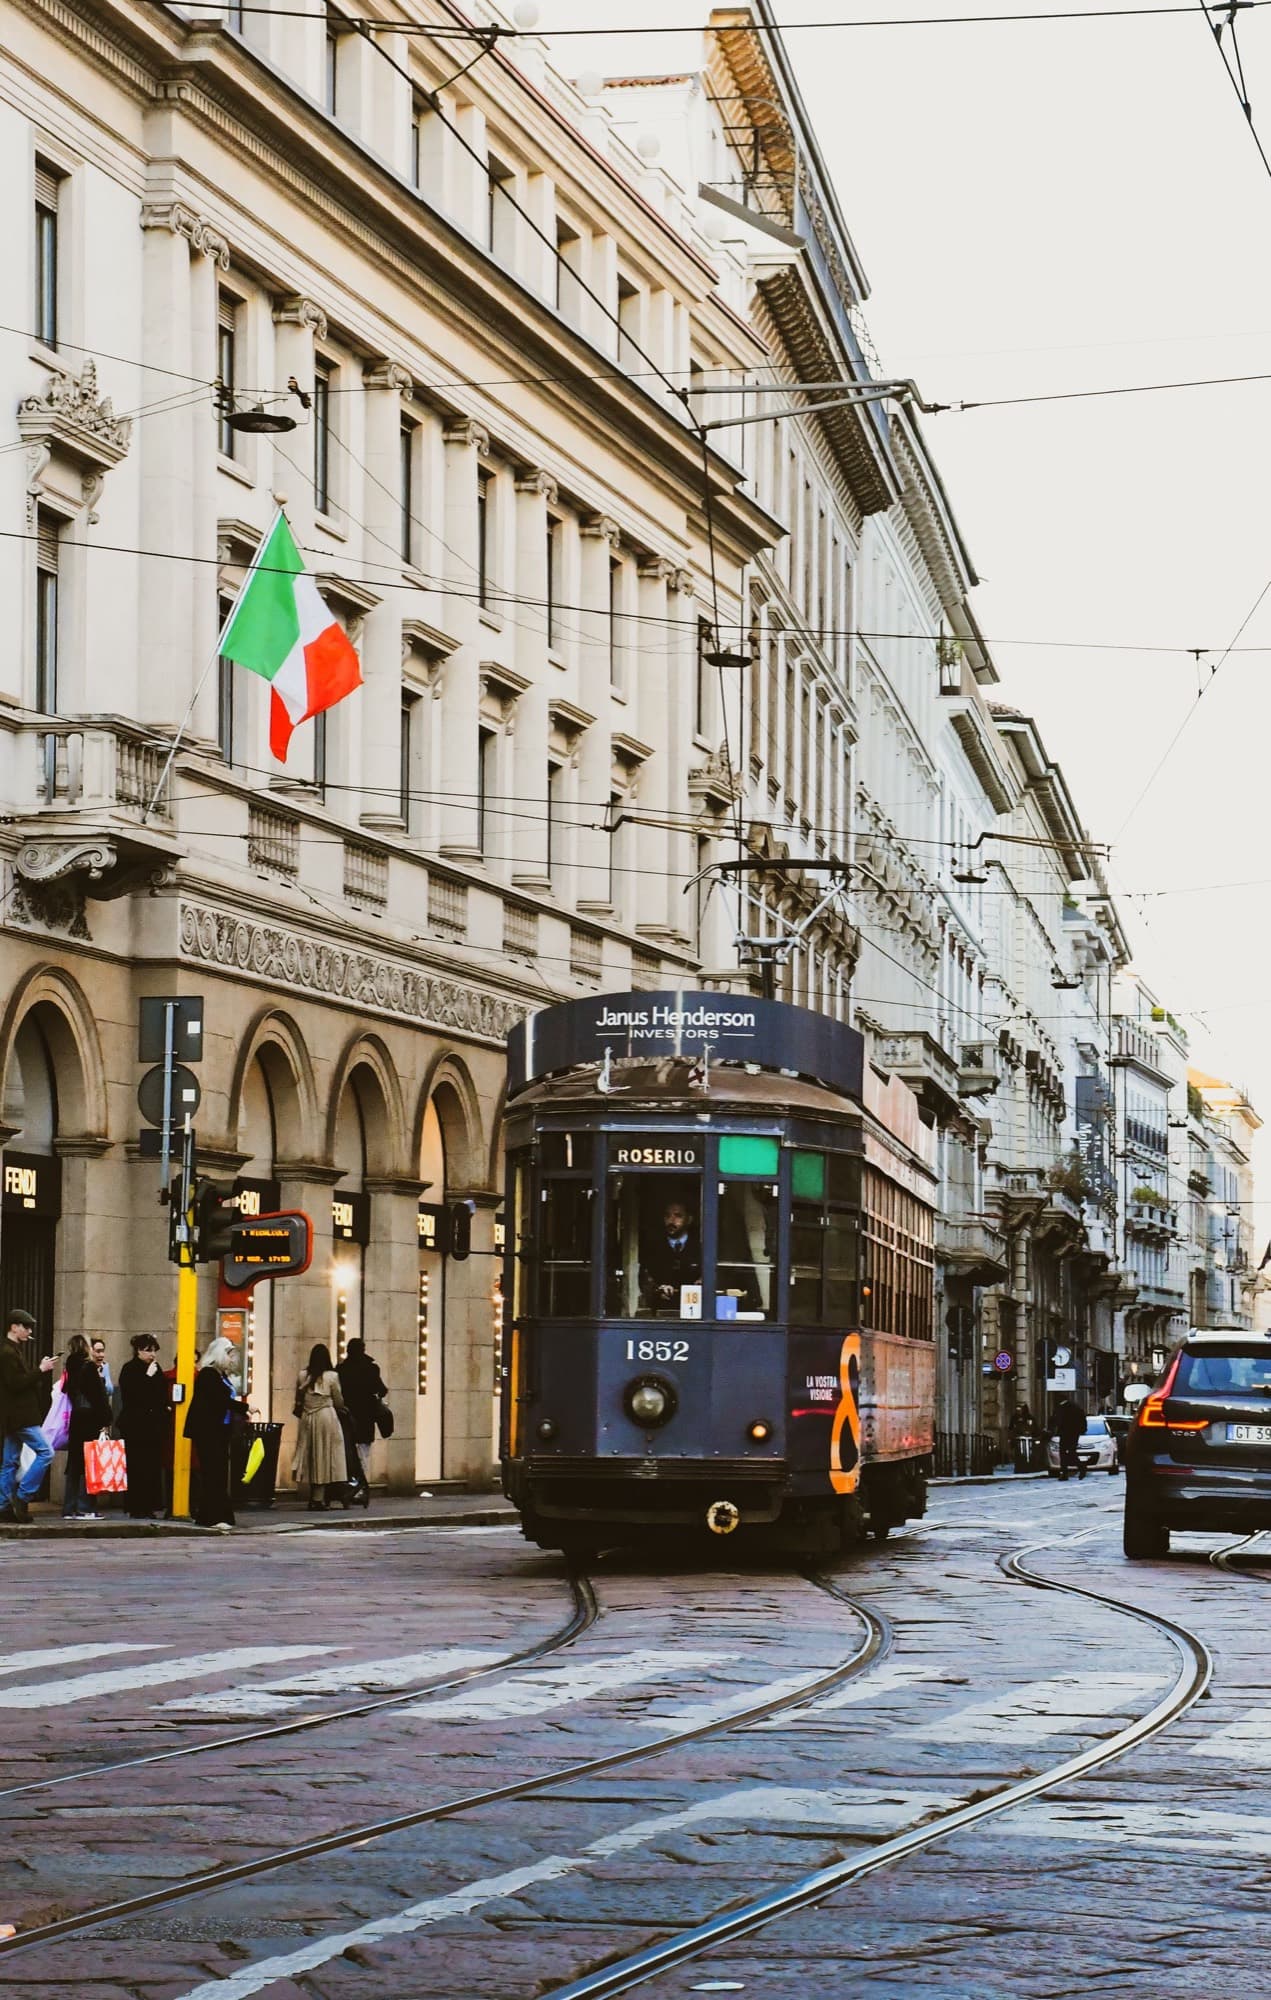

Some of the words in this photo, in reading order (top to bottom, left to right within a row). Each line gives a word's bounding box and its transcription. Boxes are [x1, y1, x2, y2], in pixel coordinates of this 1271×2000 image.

[595, 1006, 648, 1026] Janus
[652, 1006, 755, 1026] Henderson
[629, 1029, 719, 1039] INVESTORS
[565, 1133, 573, 1167] 1
[617, 1149, 695, 1163] ROSERIO
[5, 1166, 36, 1196] FENDI
[626, 1340, 689, 1361] 1852
[806, 1376, 813, 1387] LA
[815, 1376, 838, 1388] VOSTRA
[810, 1389, 833, 1400] VISIONE
[1236, 1426, 1250, 1438] GT
